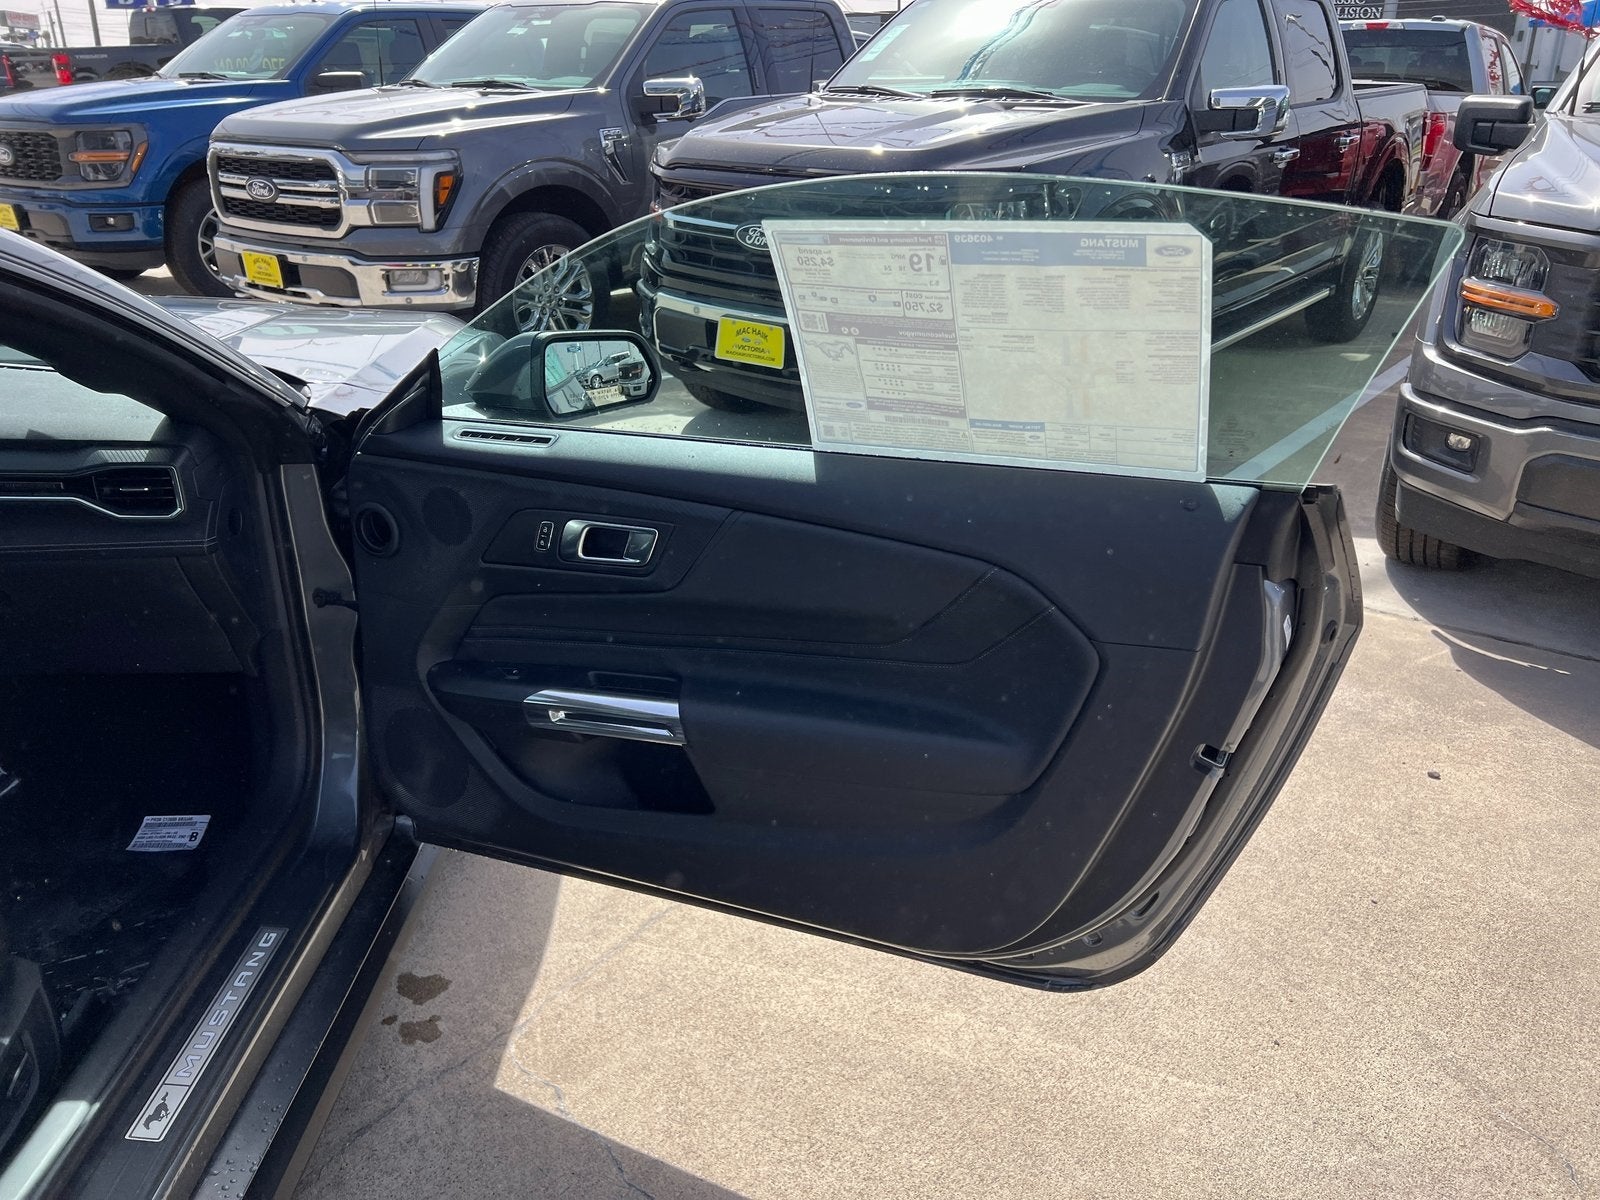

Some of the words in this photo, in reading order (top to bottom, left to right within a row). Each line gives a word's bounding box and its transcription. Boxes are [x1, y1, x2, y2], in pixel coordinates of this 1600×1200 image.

[1336, 6, 1383, 19] LISION
[251, 181, 270, 197] Ford
[745, 228, 767, 246] For
[735, 326, 751, 337] MAC
[751, 327, 769, 343] HAIK
[737, 343, 765, 354] VICTORIA
[189, 831, 199, 842] B
[175, 931, 277, 1078] MUSTANG
